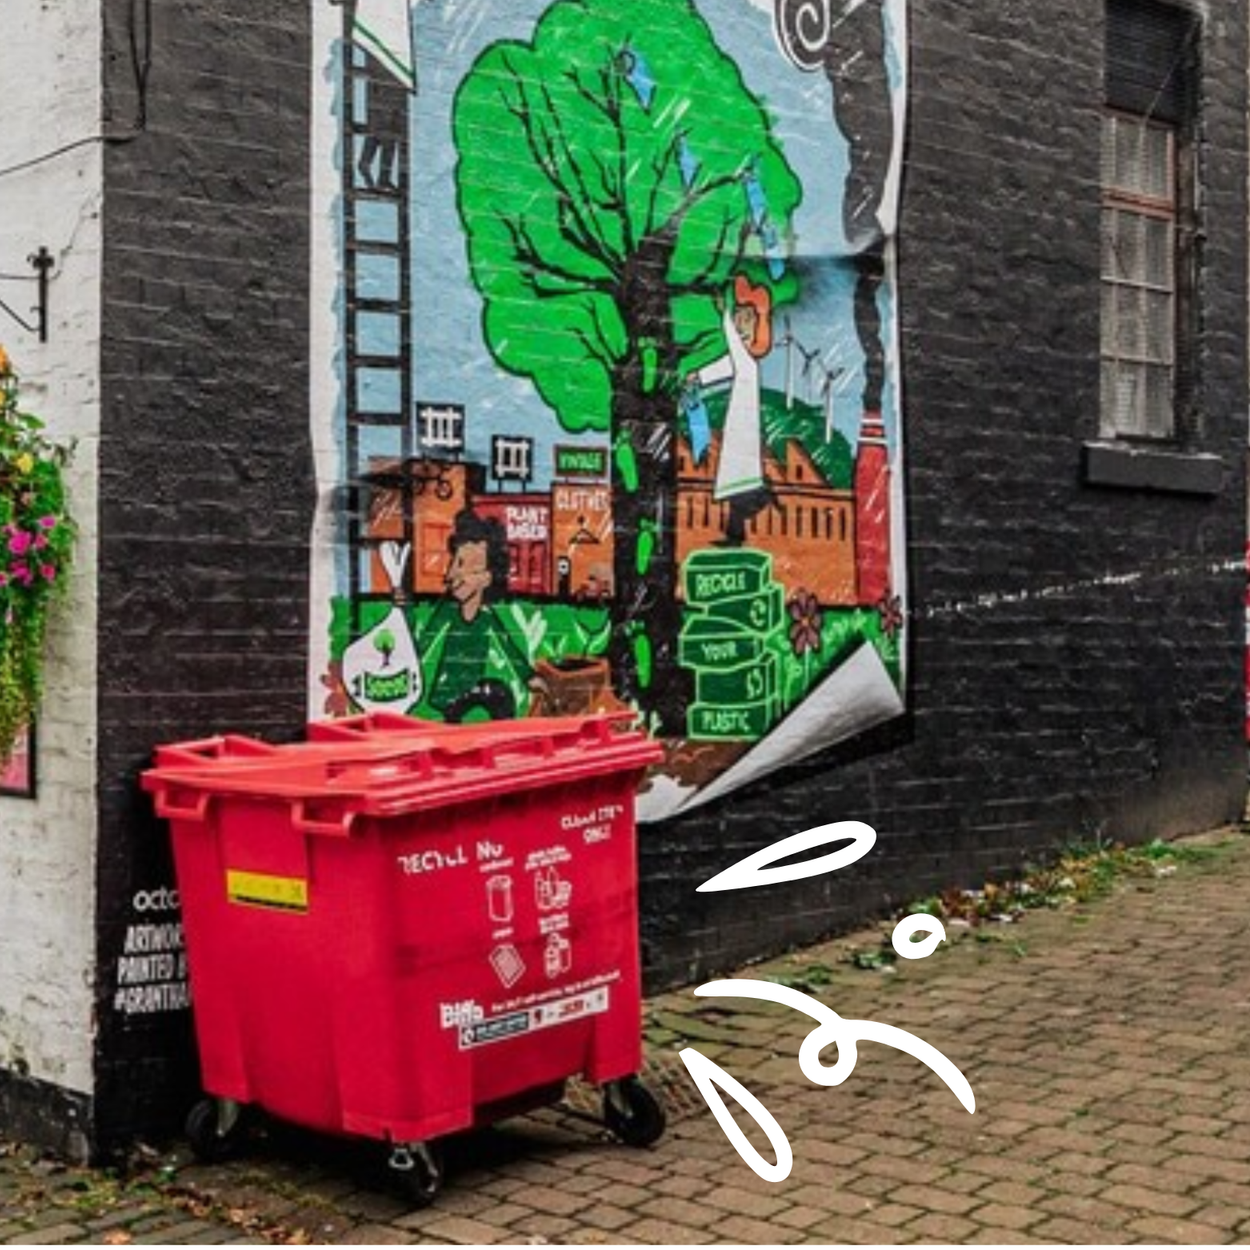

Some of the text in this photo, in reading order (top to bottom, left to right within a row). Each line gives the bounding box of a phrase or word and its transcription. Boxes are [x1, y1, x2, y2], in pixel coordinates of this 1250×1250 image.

[506, 506, 549, 524] PLANT
[695, 572, 746, 598] RECYCLE
[702, 641, 738, 661] YOUR
[701, 709, 751, 732] PLASTIC
[117, 953, 174, 985] PAINTED
